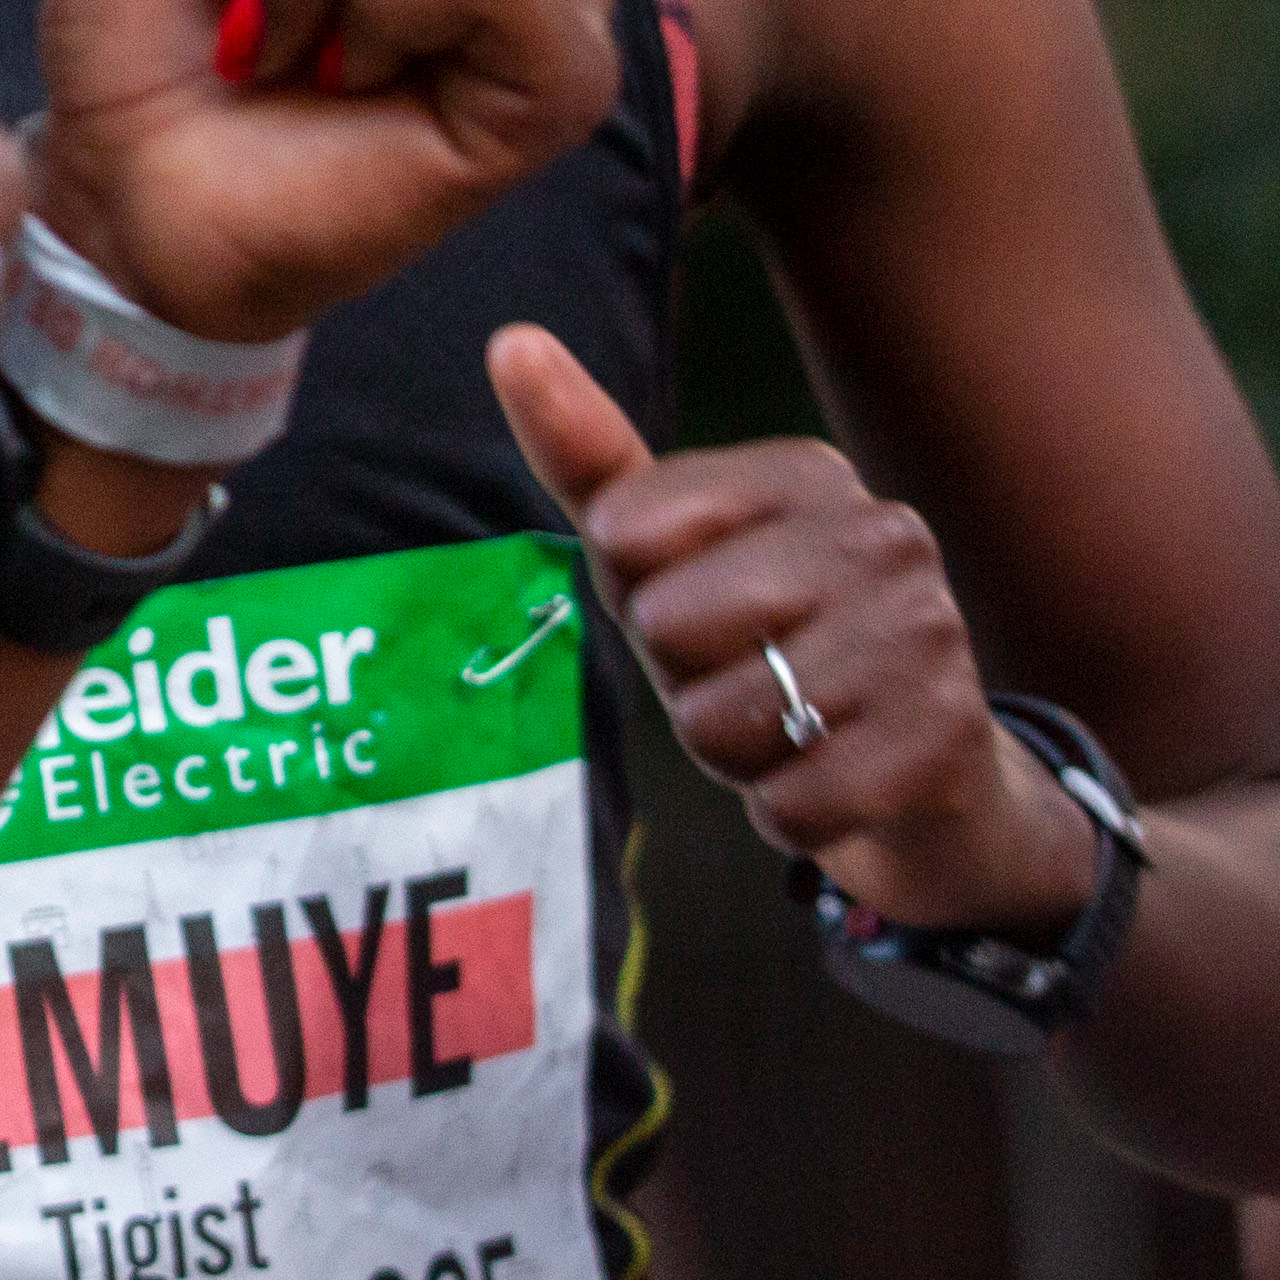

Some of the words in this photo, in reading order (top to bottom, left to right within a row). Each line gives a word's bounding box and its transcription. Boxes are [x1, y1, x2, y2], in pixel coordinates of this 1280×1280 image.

[38, 616, 377, 751] eider
[40, 722, 377, 822] Electric
[41, 1180, 269, 1280] Tigist
